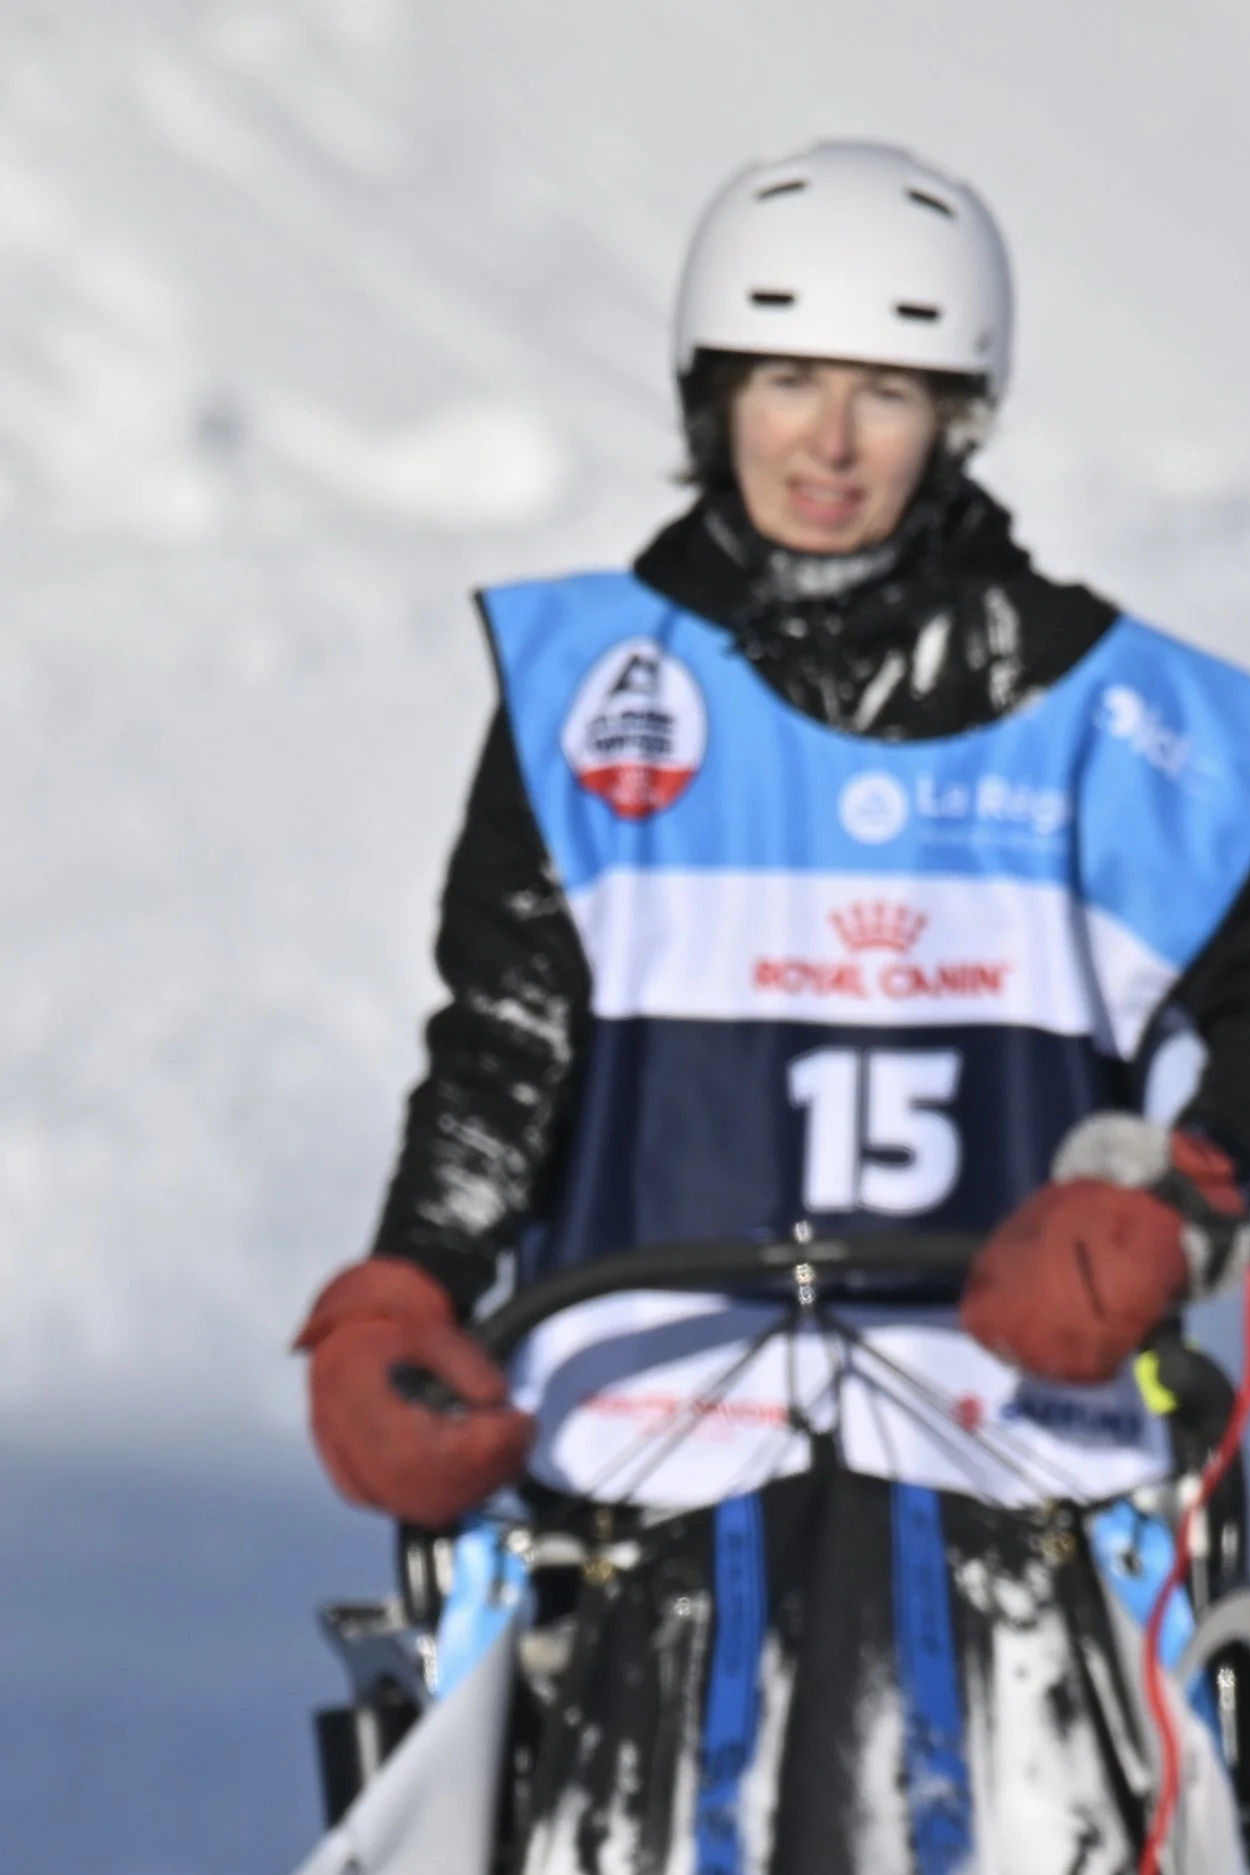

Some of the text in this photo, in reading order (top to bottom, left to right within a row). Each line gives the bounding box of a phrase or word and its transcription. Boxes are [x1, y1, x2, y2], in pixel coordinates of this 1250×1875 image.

[752, 957, 1005, 1002] ROYAL CANIN
[788, 1046, 964, 1218] 15
